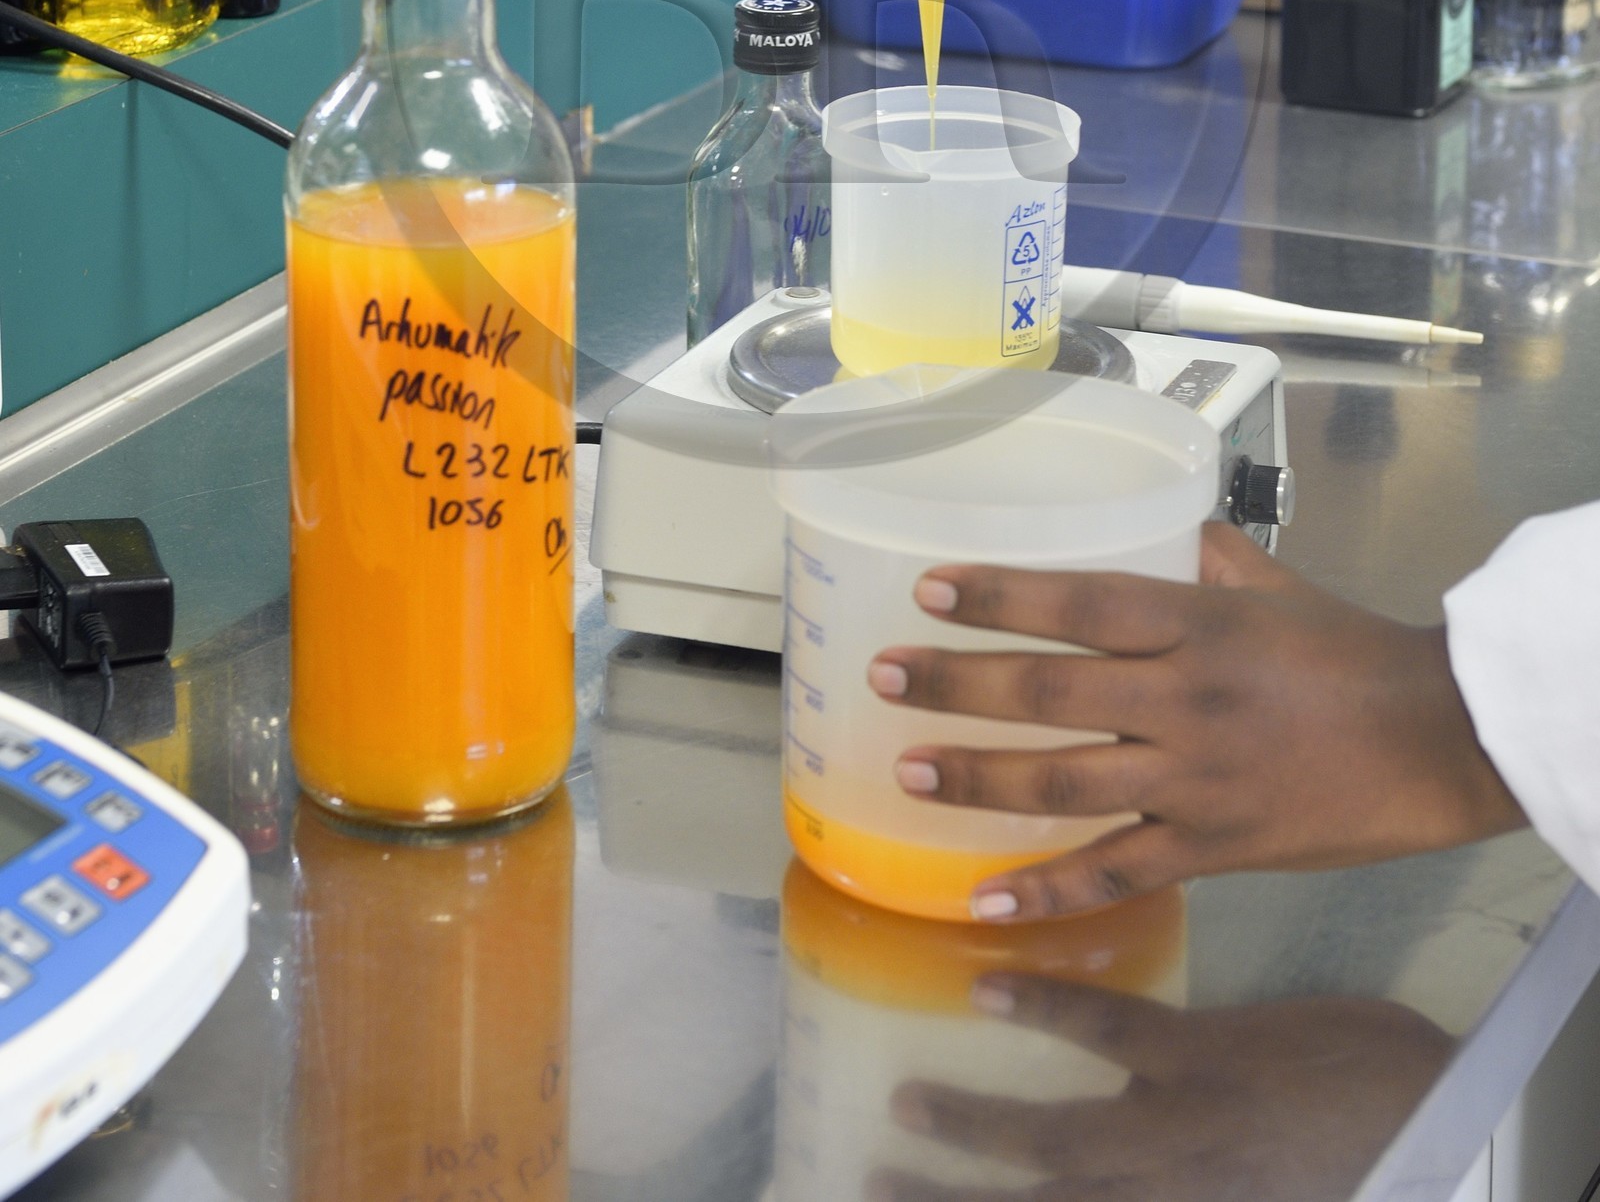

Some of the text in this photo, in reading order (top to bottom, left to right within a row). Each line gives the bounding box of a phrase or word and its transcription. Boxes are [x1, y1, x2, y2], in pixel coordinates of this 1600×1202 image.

[749, 33, 813, 48] MALOYA
[1023, 244, 1030, 257] 5
[378, 369, 495, 429] passion
[428, 497, 504, 530] 1056
